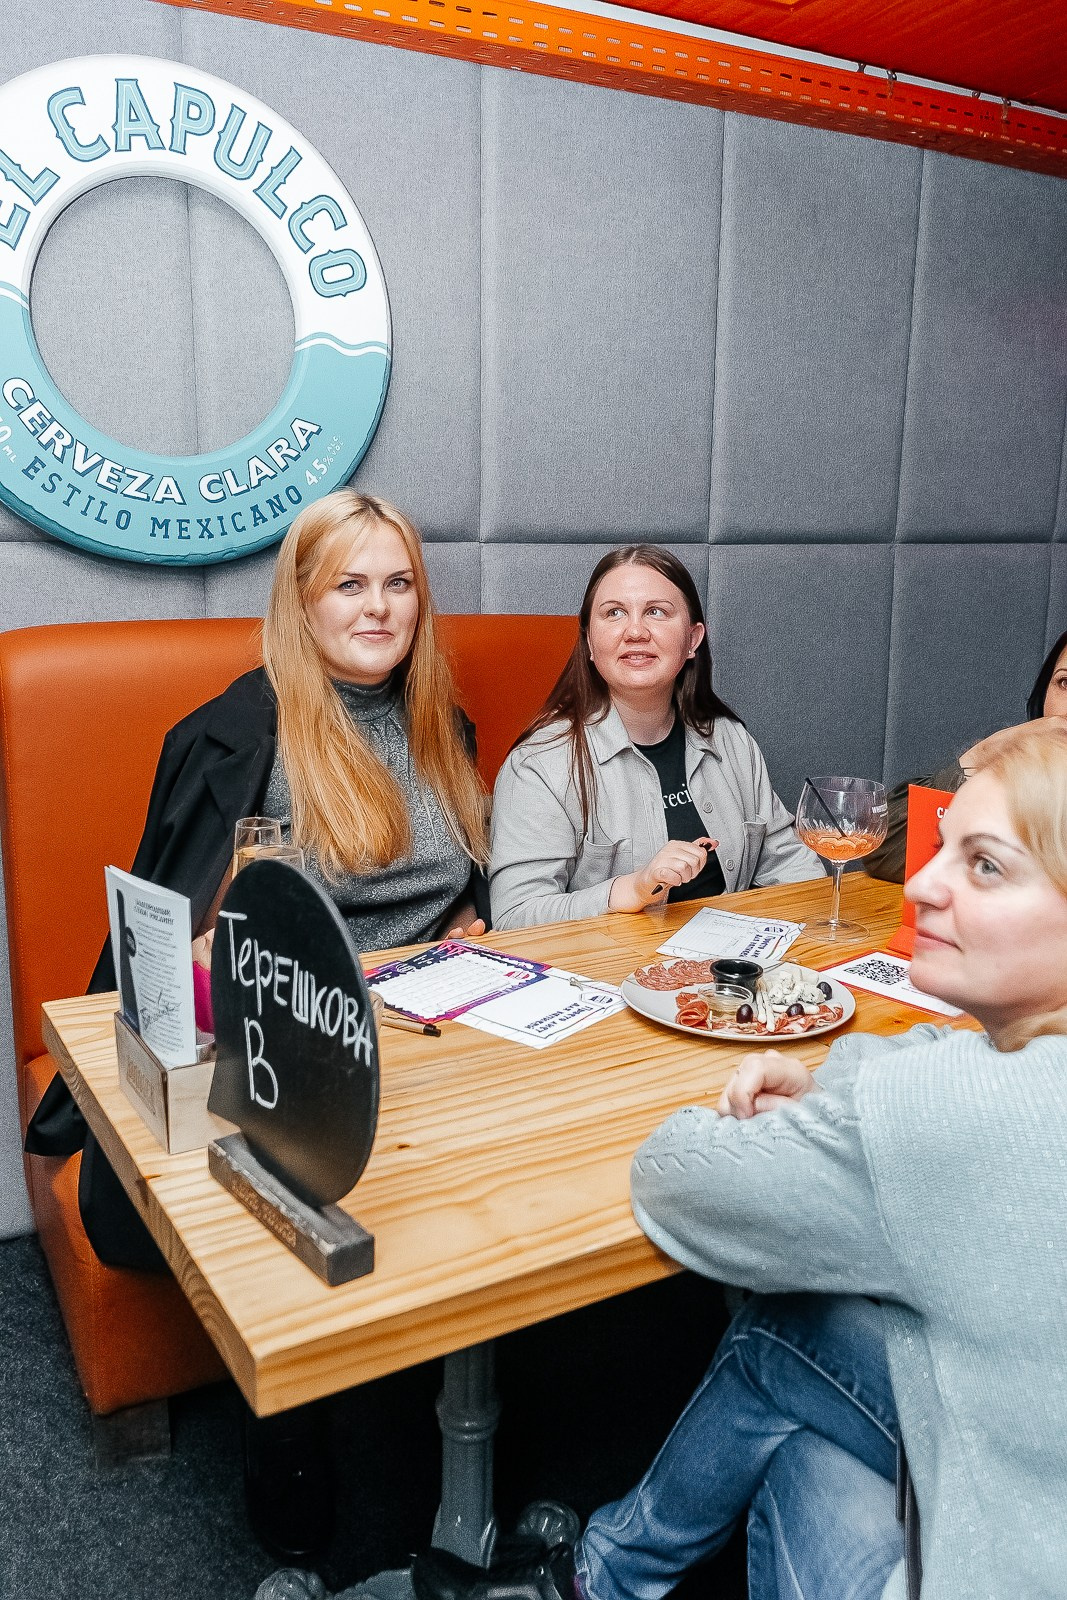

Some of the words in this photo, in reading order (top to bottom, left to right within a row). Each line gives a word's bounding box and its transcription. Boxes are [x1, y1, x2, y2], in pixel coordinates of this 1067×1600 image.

[46, 78, 368, 298] CAPULCO
[2, 377, 187, 505] CERVEZA
[198, 417, 323, 503] CLARA
[305, 456, 334, 486] 4.5%
[21, 455, 132, 530] ESTILO
[149, 485, 303, 539] MEXICANO
[244, 1016, 279, 1109] В
